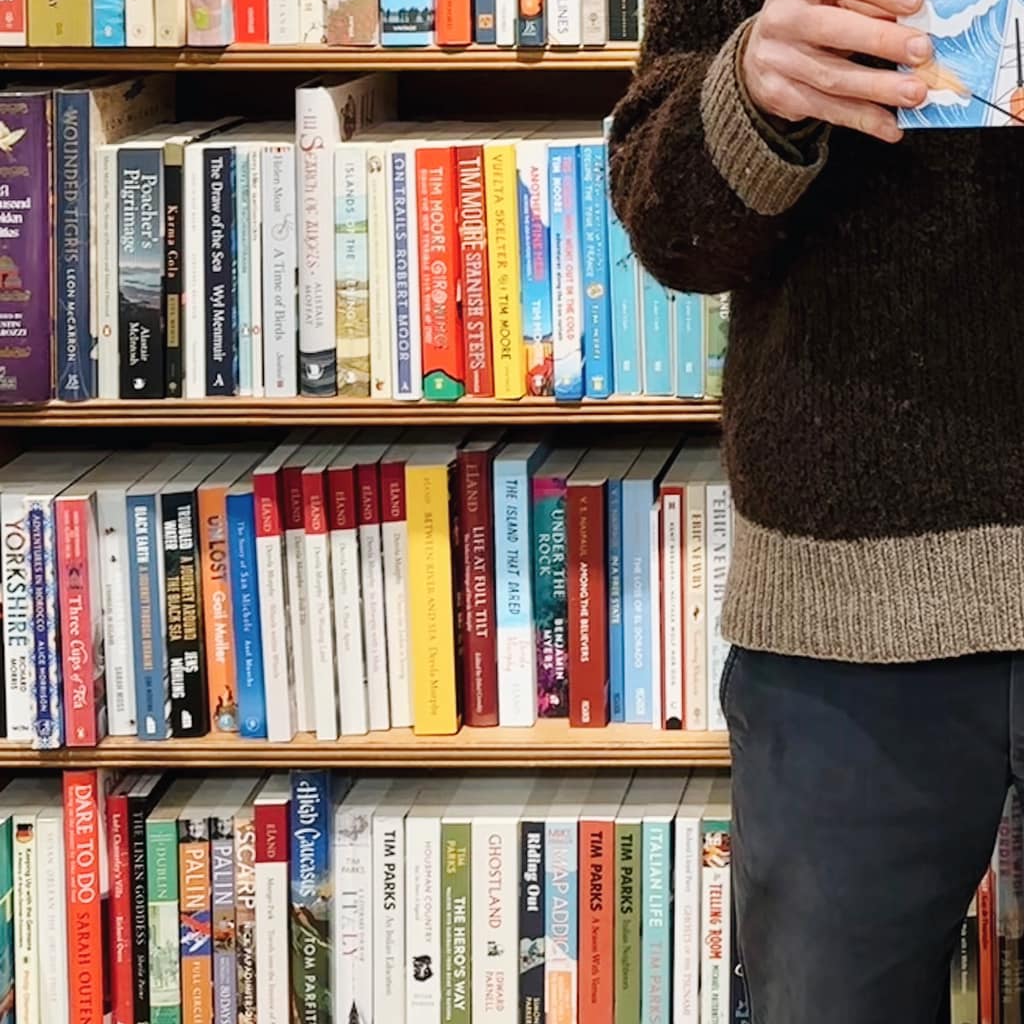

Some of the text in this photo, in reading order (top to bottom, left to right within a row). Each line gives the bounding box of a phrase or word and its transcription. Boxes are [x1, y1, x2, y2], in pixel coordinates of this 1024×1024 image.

[63, 107, 78, 203] WOUNDED
[211, 157, 224, 180] The
[123, 169, 140, 254] Pilgrimage
[141, 172, 158, 249] Poacher's
[211, 182, 224, 213] Draw
[430, 168, 445, 252] TIM MOORE
[63, 208, 79, 262] TIGRIS
[211, 228, 224, 249] the
[394, 158, 409, 360] ON TRAILS ROBERT MOOR
[458, 156, 485, 371] TIM MOORE SPANISH STEPS
[66, 269, 76, 298] LEON
[211, 285, 225, 307] Wyl
[212, 309, 226, 362] Menmuir
[505, 479, 520, 615] THE ISLAND THAT DARED
[538, 534, 550, 575] ROCK
[552, 510, 564, 598] UNDER THE
[5, 520, 25, 646] YORKSHIRE
[213, 592, 227, 619] Gail
[67, 596, 82, 636] Three
[213, 622, 230, 664] Muller
[68, 639, 88, 671] Cups
[70, 687, 84, 709] Tea
[74, 784, 93, 836] DARE
[76, 840, 94, 867] TO
[184, 847, 207, 908] PALIN
[213, 846, 232, 905] PALIN
[295, 830, 321, 897] Caucasus
[384, 831, 396, 911] TIM PARKS
[488, 834, 502, 929] GHOSTLAND
[524, 832, 540, 911] Riding Out
[590, 831, 603, 911] TIM PARKS
[620, 834, 632, 914] TIM PARKS
[649, 829, 663, 927] ITALIAN LIFE
[77, 872, 95, 903] DO
[77, 912, 90, 964] SARAH
[453, 897, 465, 1009] THE HERO'S WAY
